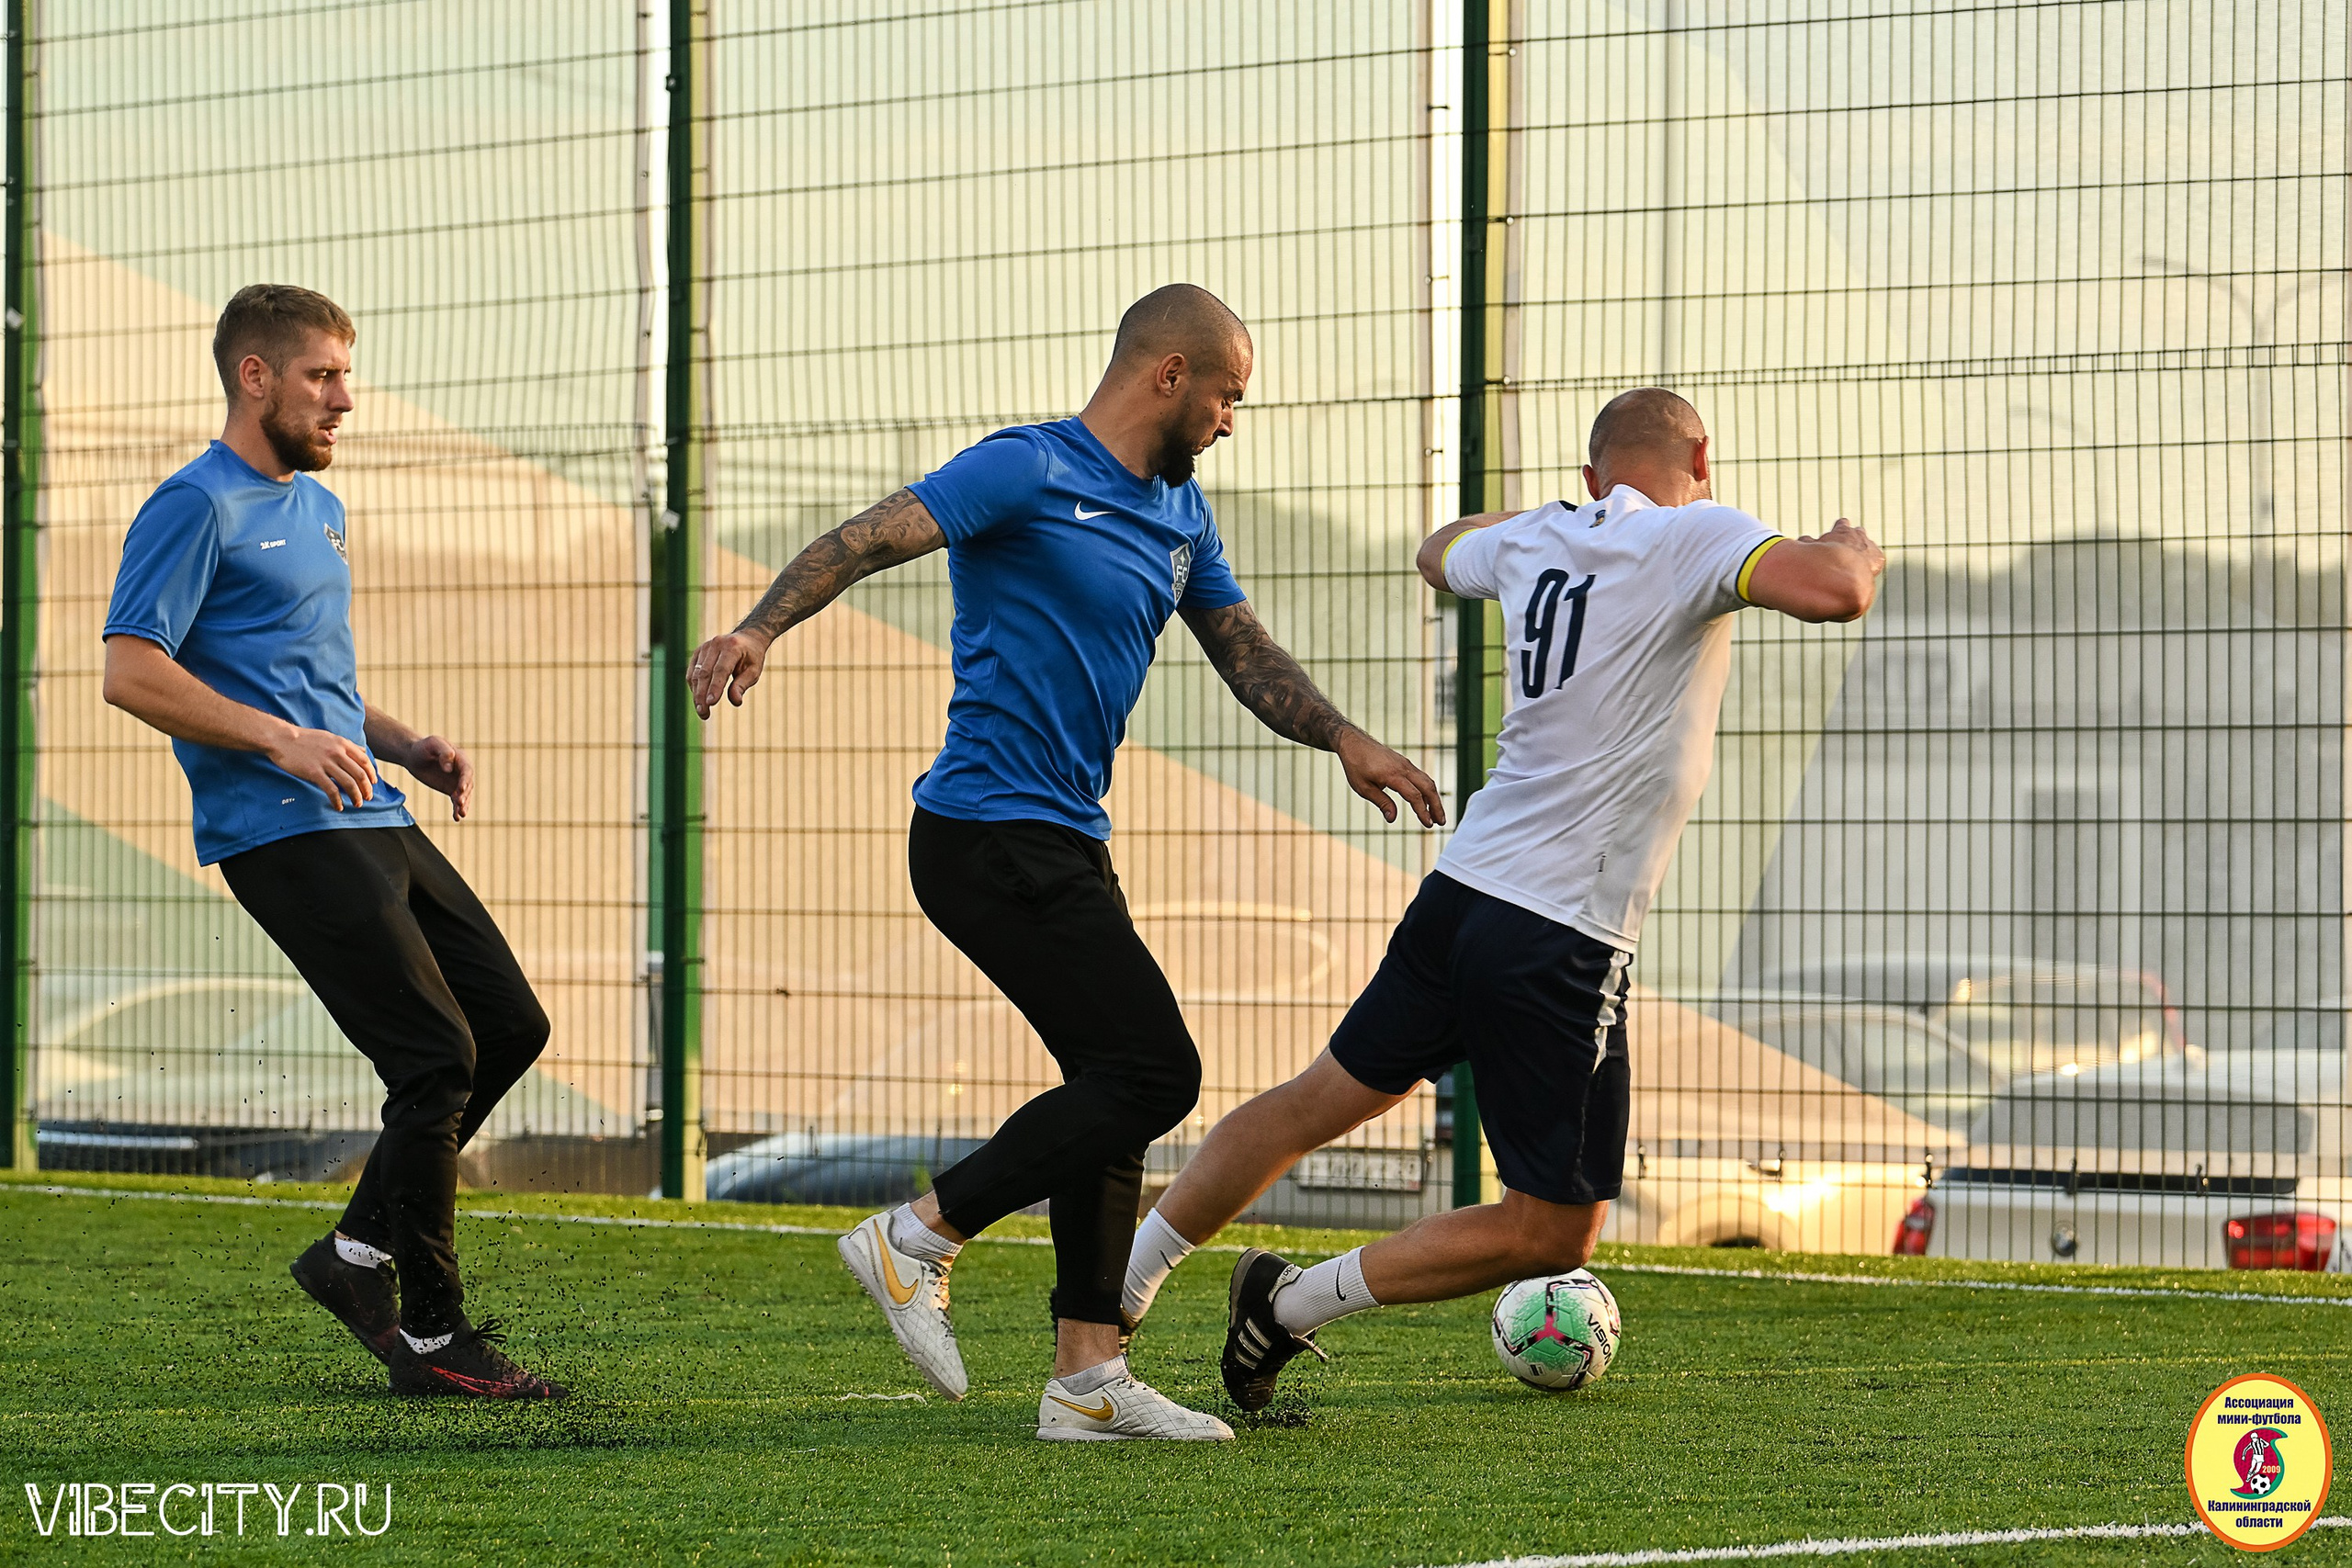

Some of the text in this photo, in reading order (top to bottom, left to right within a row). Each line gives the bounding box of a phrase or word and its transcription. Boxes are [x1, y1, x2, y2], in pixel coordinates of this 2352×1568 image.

[1175, 564, 1188, 582] FC
[1521, 568, 1597, 698] 91
[1588, 1313, 1612, 1366] VISION
